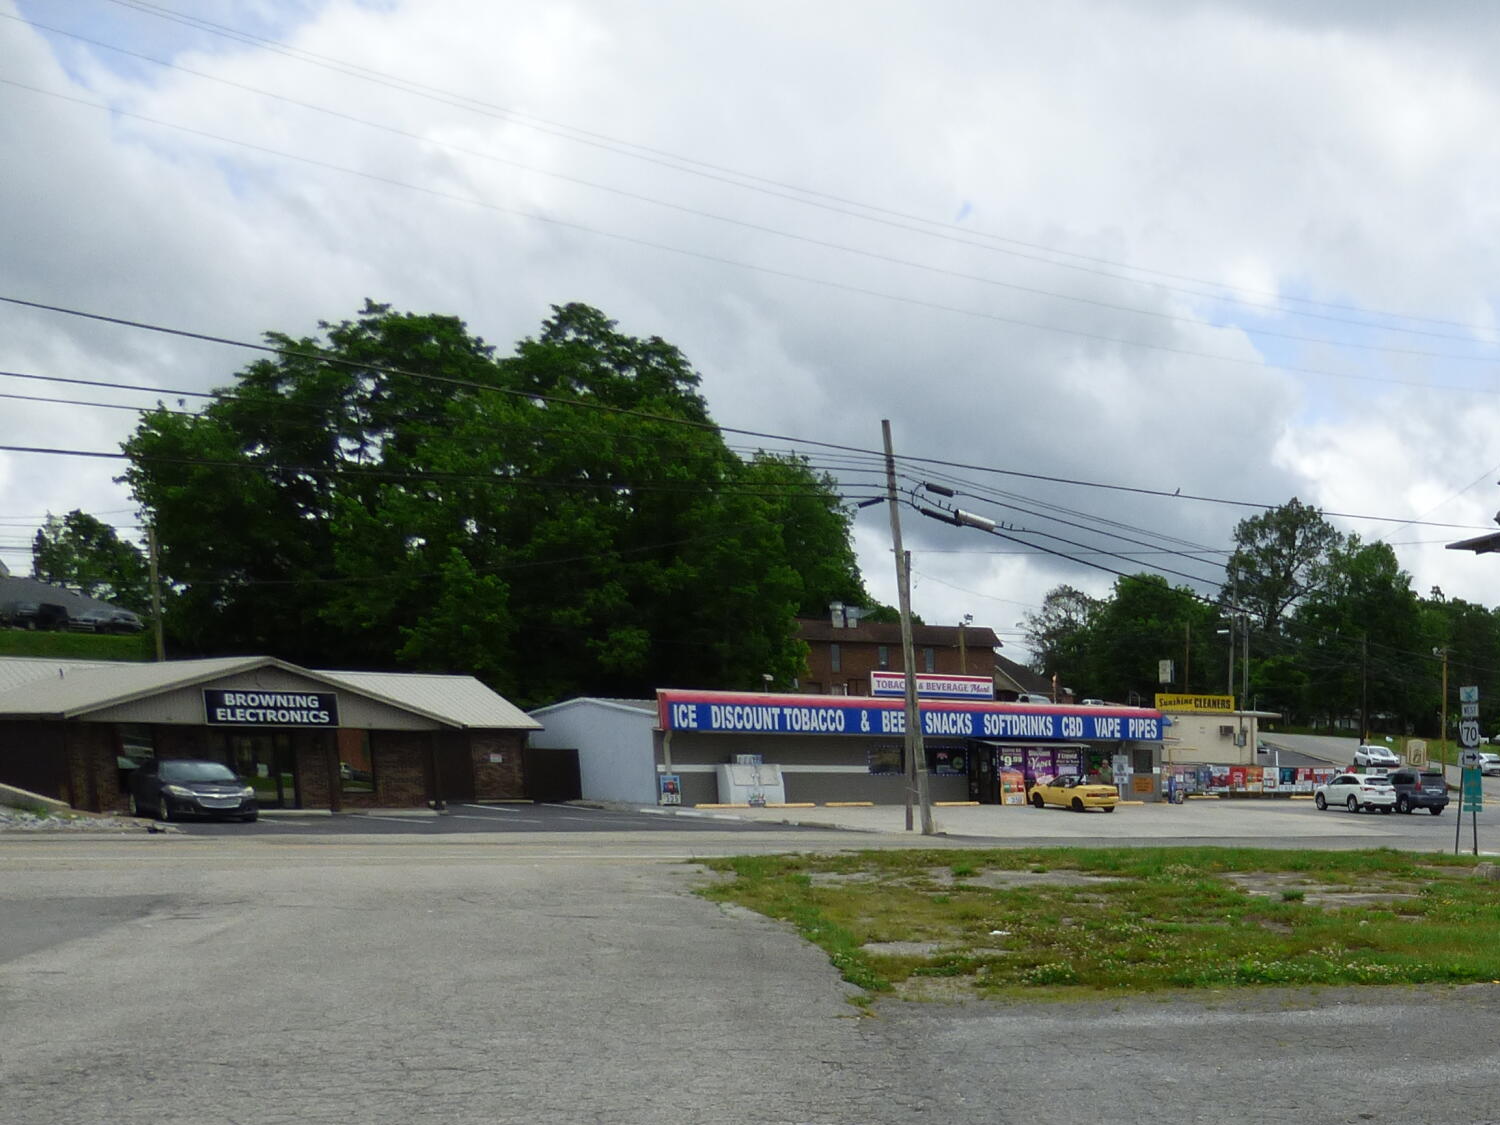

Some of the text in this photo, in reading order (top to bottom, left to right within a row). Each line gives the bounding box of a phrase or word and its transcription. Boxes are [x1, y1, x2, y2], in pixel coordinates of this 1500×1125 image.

[876, 679, 906, 690] TOBAC
[926, 682, 968, 692] BEVERAGE
[223, 693, 320, 708] BROWNING
[216, 708, 330, 723] ELECTRONICS
[673, 704, 1158, 739] ICE DISCOUNT TOBACCO & BEE SNACKS SOFTDRINKS CBD VAPE PIPES
[1464, 726, 1477, 741] 70
